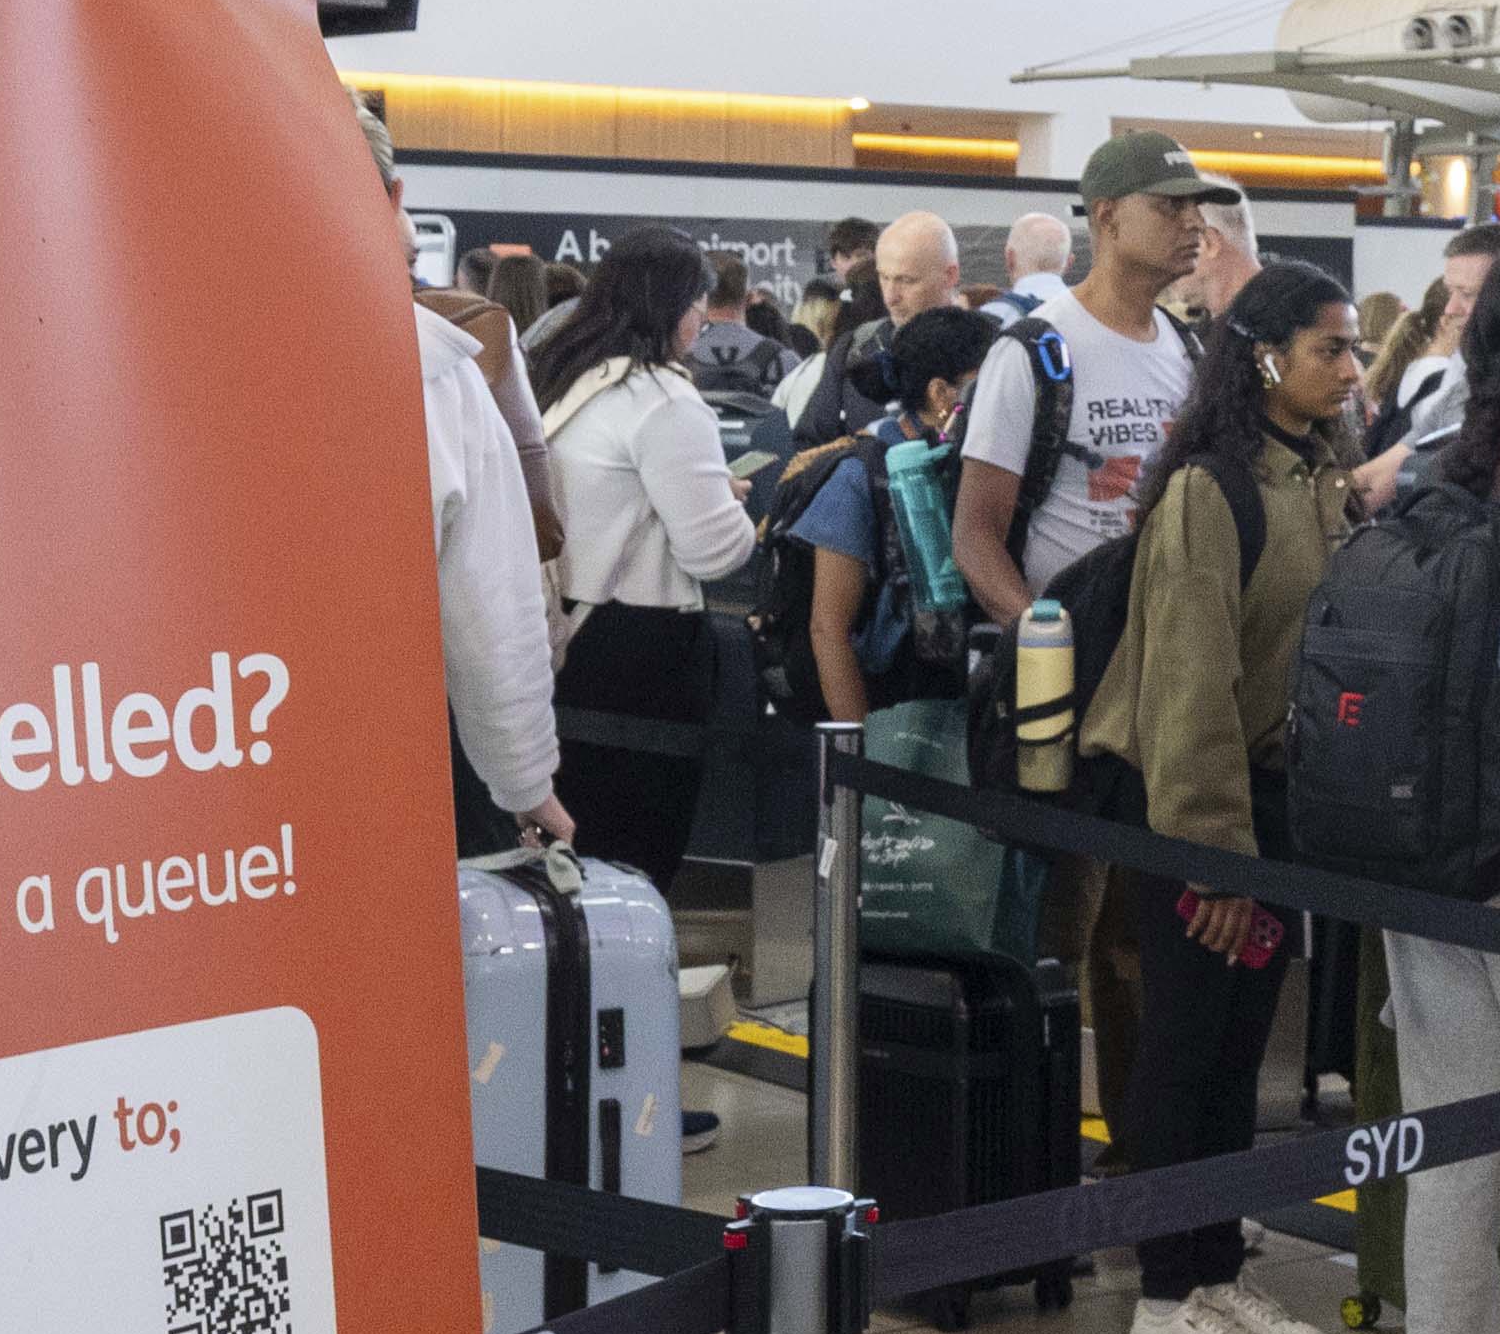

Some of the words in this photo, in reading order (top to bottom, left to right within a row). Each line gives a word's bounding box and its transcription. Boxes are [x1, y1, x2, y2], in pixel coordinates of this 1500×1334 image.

[1088, 422, 1159, 447] VIBES
[15, 873, 55, 933] a
[73, 824, 298, 944] queue!
[113, 1095, 182, 1153] to;
[1345, 1117, 1425, 1187] SYD
